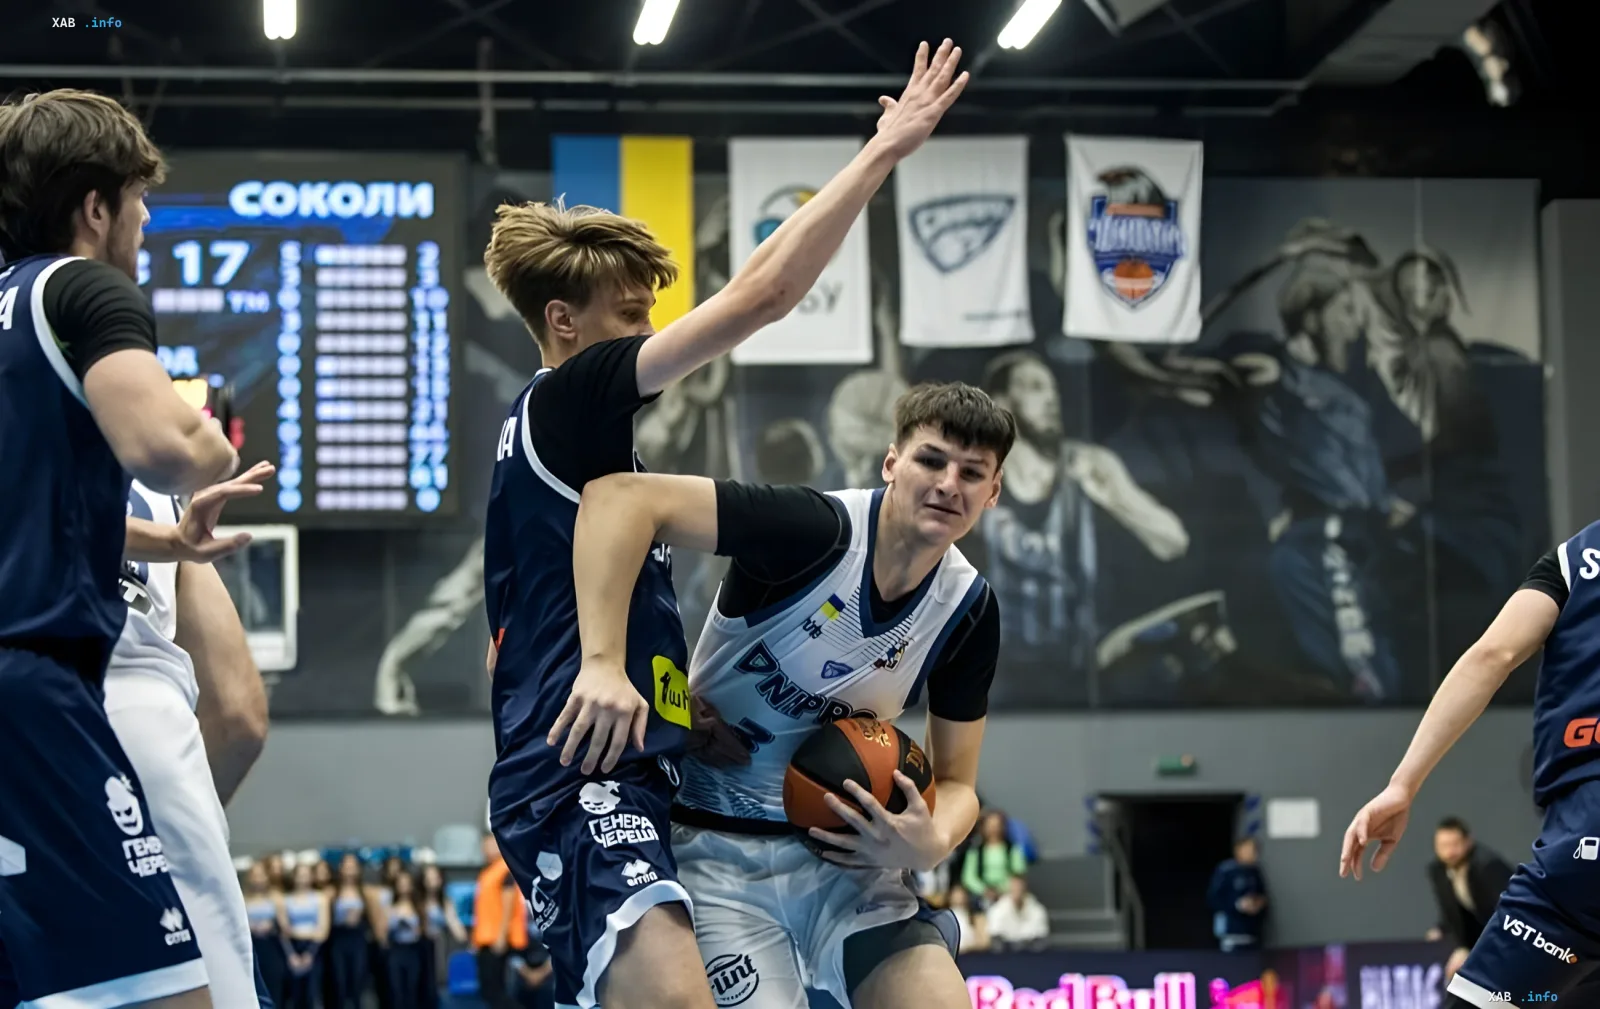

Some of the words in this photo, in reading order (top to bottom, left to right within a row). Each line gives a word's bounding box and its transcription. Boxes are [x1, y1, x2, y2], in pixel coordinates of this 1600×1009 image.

[229, 181, 434, 218] СОКОЛИ
[172, 239, 251, 286] 17
[1563, 717, 1600, 748] G
[1503, 914, 1537, 942] VST
[1532, 931, 1575, 965] bank
